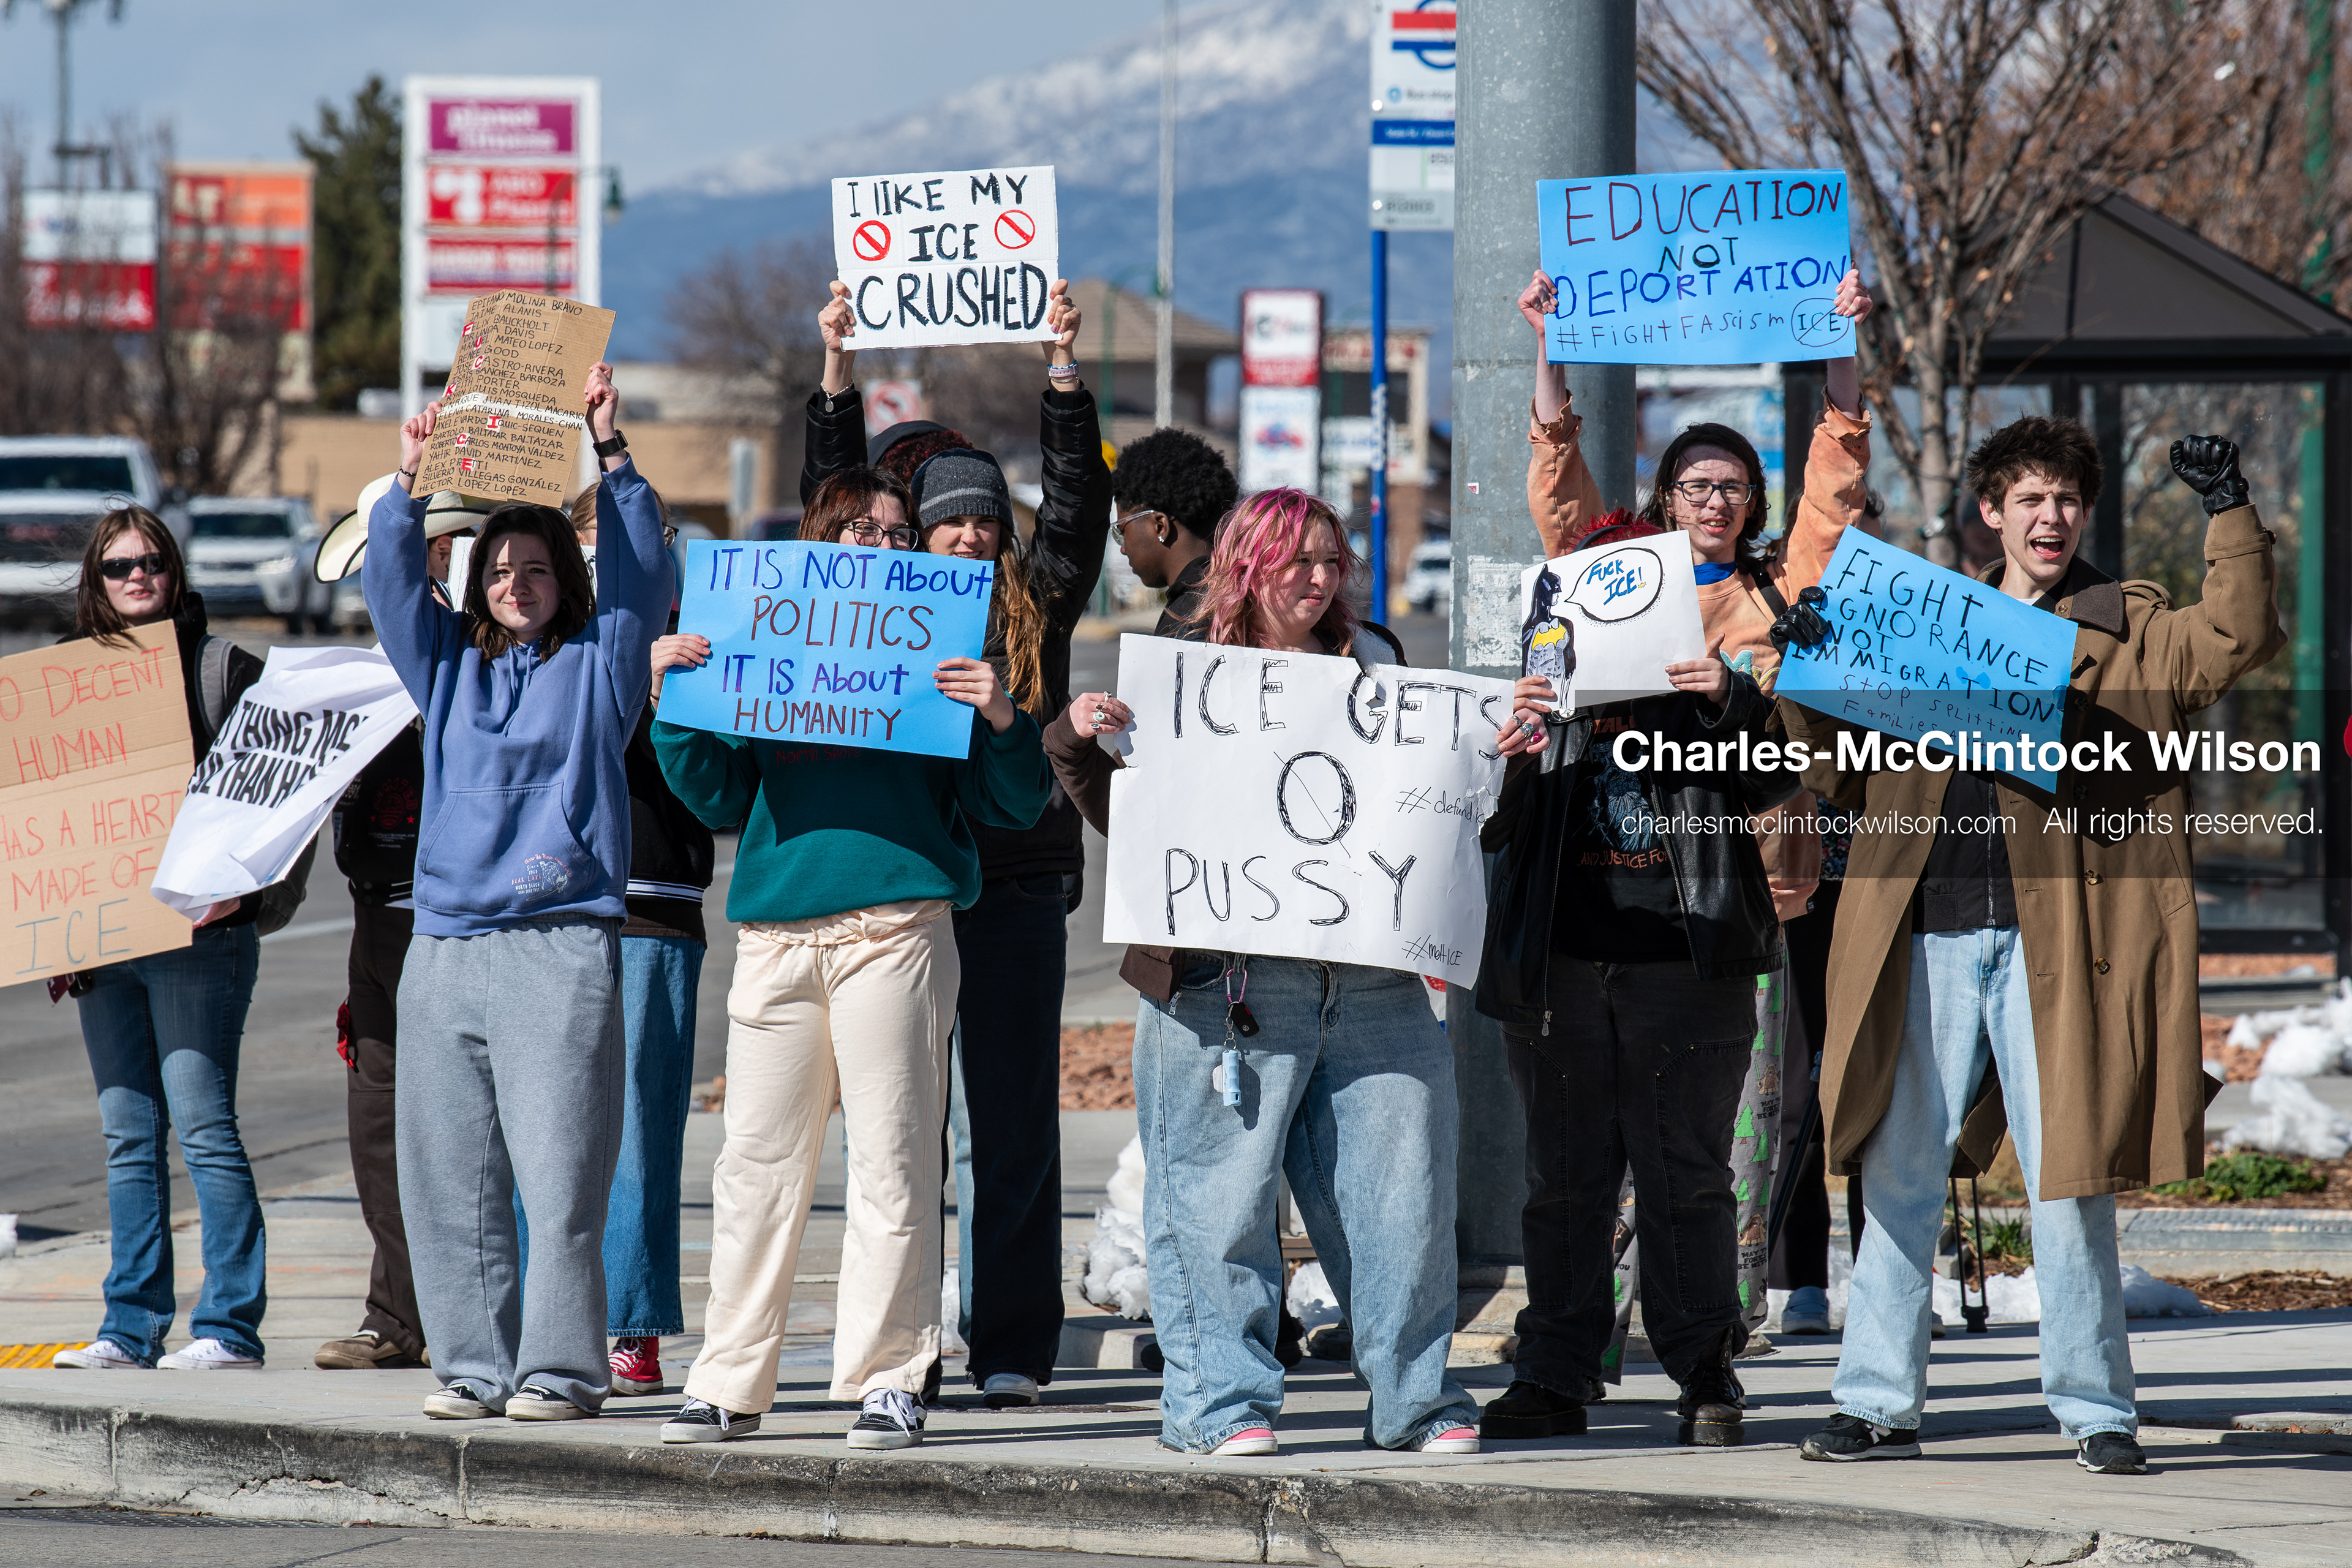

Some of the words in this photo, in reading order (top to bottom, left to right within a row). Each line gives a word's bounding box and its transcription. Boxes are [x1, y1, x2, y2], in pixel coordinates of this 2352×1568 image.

[847, 181, 861, 217] I
[970, 172, 1028, 205] MY
[1566, 180, 1842, 246] EDUCATION
[908, 223, 979, 262] ICE
[1658, 237, 1738, 272] NOT
[472, 292, 505, 311] EPIFANO
[505, 293, 546, 307] MOLINA
[552, 300, 582, 315] BRAVO
[856, 260, 1047, 331] CRUSHED
[462, 317, 491, 337] FELIX
[493, 314, 549, 331] BAUCKHOLT
[470, 304, 497, 322] JAIME
[503, 303, 541, 317] ALANIS
[459, 334, 489, 353] MANUEL
[529, 341, 563, 355] LOPEZ
[504, 326, 535, 339] DAVIS
[454, 360, 473, 375] JOSE
[474, 356, 564, 379] CASTRO-RIVERA
[458, 349, 481, 364] RENEE
[484, 345, 519, 358] GOOD
[445, 377, 473, 397] KEITH
[477, 374, 519, 390] PORTER
[475, 367, 516, 379] SANCHEZ
[519, 373, 565, 386] BARBOZA
[442, 394, 479, 411] ENRIQUE
[483, 396, 512, 405] JUAN
[545, 405, 584, 420] MACARIO
[499, 388, 556, 405] MOSQUEDA
[439, 407, 463, 421] ELENA
[466, 404, 510, 418] CATARINA
[432, 427, 464, 442] BARTOLO
[469, 427, 507, 440] BALTAZAR
[511, 434, 564, 449] BALTAZAR
[457, 434, 489, 448] CARLOS
[491, 442, 526, 453] MONTOYA
[528, 447, 566, 461] VALDEZ
[424, 460, 447, 474] ALEX
[450, 458, 488, 471] PRETTI
[455, 447, 481, 458] DAVID
[485, 452, 542, 469] MARTINEZ
[419, 477, 453, 493] HECTOR
[458, 478, 491, 492] LOPEZ
[494, 484, 527, 496] LOPEZ
[423, 467, 454, 482] SILVERIO
[459, 468, 505, 482] VILLEGAS
[710, 548, 743, 591] IT
[753, 548, 783, 589] IS
[802, 550, 877, 589] NOT
[884, 560, 992, 599] About
[1586, 559, 1624, 585] FUCK
[1837, 548, 1983, 628] FIGHT
[751, 595, 934, 650] POLITICS
[1827, 619, 1893, 654] NOT
[42, 646, 164, 718] DECENT
[722, 654, 756, 693] IT
[768, 657, 794, 695] IS
[812, 663, 910, 696] About
[1174, 651, 1288, 739] ICE
[734, 697, 902, 741] HUMANITY
[13, 723, 127, 784] HUMAN
[60, 809, 75, 847] A
[92, 790, 183, 846] HEART
[1599, 850, 1648, 869] JUSTICE
[11, 861, 100, 911] MADE
[111, 846, 157, 888] OF
[511, 877, 525, 886] BEAR
[528, 873, 541, 882] LAKE
[1166, 848, 1417, 935] PUSSY
[15, 898, 133, 974] ICE
[1741, 1250, 1759, 1258] MAY
